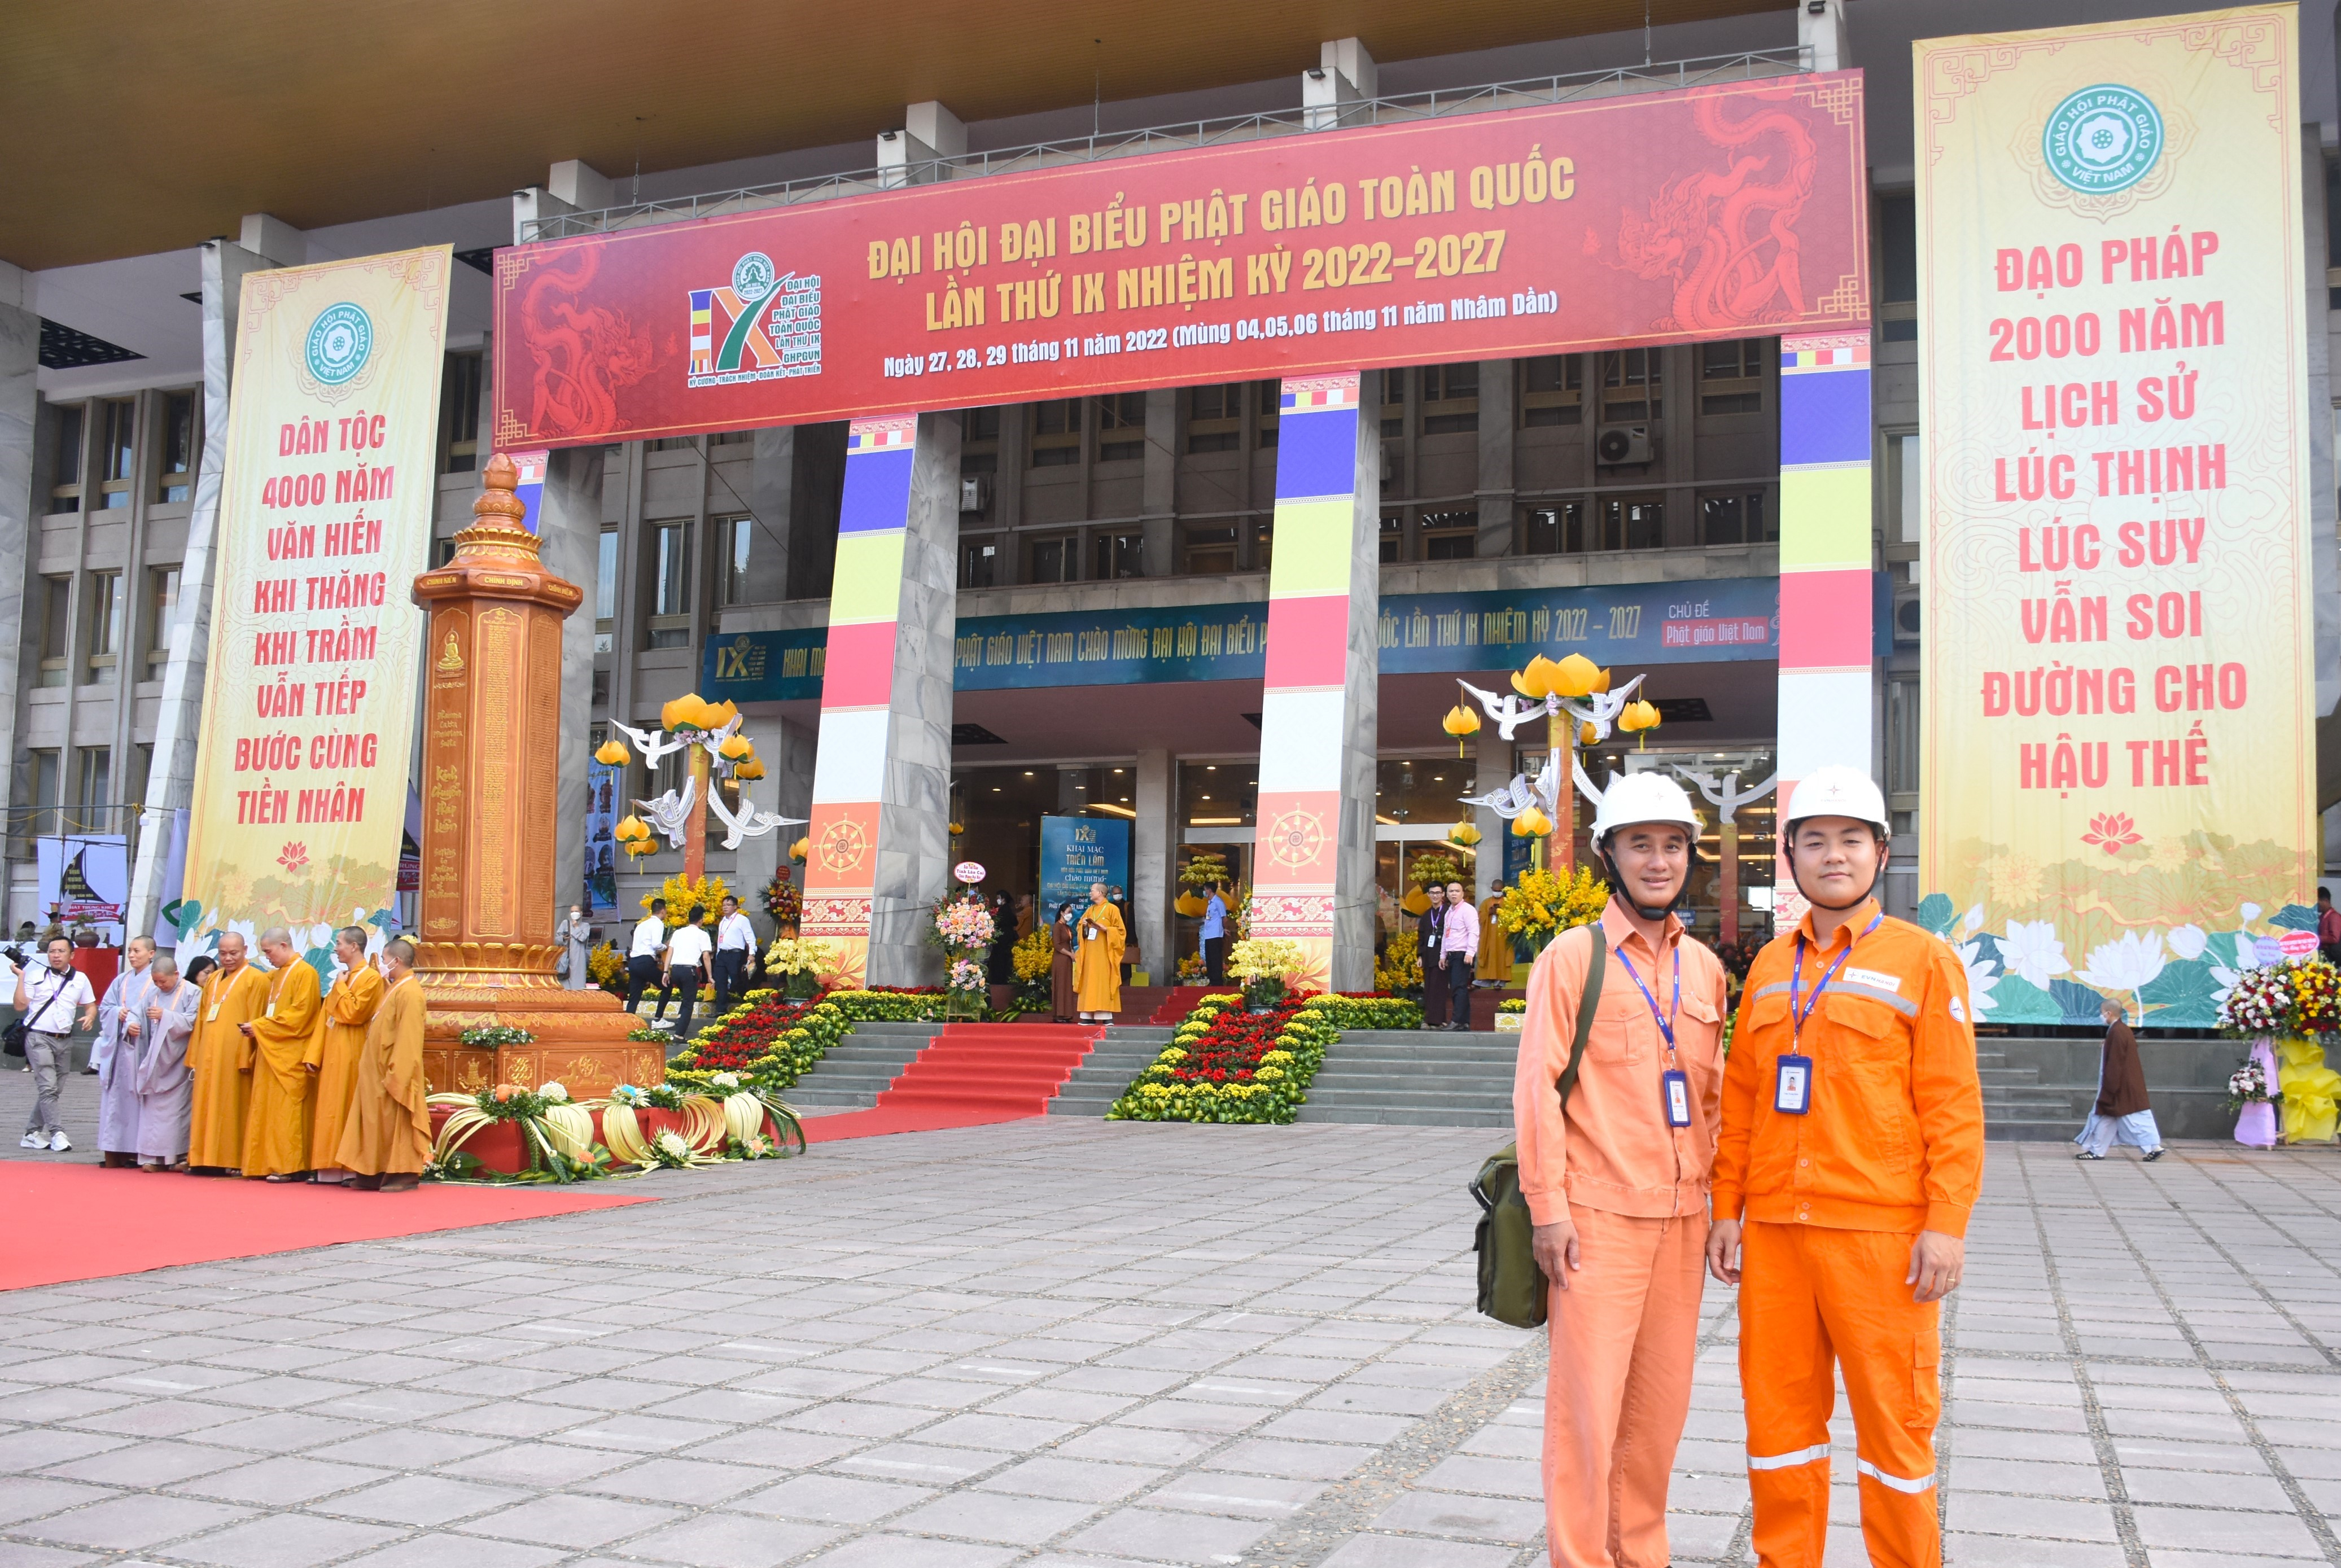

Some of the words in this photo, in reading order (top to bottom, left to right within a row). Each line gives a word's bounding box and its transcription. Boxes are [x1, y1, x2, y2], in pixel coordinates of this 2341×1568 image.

[2053, 121, 2069, 156] GIÁO
[2067, 98, 2093, 119] HỘI
[2097, 95, 2138, 113] PHẬT
[2136, 114, 2154, 149] GIÁO
[2072, 166, 2101, 185] VIỆT
[2103, 163, 2135, 183] NAM
[867, 235, 921, 284] ĐẠI
[933, 220, 987, 276] HỘI
[999, 217, 1056, 268] ĐẠI
[1069, 191, 1147, 255] BIỂU
[1160, 188, 1248, 246] PHẬT
[1260, 177, 1346, 233] GIÁO
[1359, 165, 1455, 221] TOÀN
[1469, 143, 1575, 211] QUỐC
[787, 279, 803, 291] ĐẠI
[804, 276, 820, 290] HỘI
[926, 274, 985, 332] LẦN
[996, 270, 1062, 323] THỨ
[1073, 272, 1105, 315] IX
[1117, 253, 1233, 312] NHIỆM
[1247, 244, 1291, 296] KỲ
[1302, 229, 1506, 291] 2022-2027
[1994, 242, 2083, 299] ĐẠO
[2101, 224, 2220, 285] PHÁP
[773, 307, 796, 321] PHẬT
[798, 305, 820, 317] GIÁO
[782, 295, 797, 308] ĐẠI
[799, 289, 820, 304] BIỂU
[312, 330, 322, 356] GIÁO
[321, 313, 336, 329] HỘI
[339, 311, 361, 324] PHẬT
[358, 325, 367, 351] GIÁO
[770, 321, 792, 335] TOÀN
[795, 318, 820, 332] QUỐC
[776, 335, 790, 349] LẦN
[793, 334, 808, 347] THỨ
[811, 334, 820, 345] IX
[883, 356, 924, 378] Ngày
[929, 352, 953, 373] 27,
[956, 348, 982, 370] 28,
[986, 345, 1007, 366] 29
[1012, 338, 1060, 365] tháng
[1064, 338, 1079, 358] 11
[1083, 332, 1122, 357] năm
[1126, 328, 1168, 352] 2022
[1172, 321, 1231, 348] (Mùng
[1236, 313, 1318, 341] 04,05,06
[1323, 306, 1376, 332] tháng
[1381, 305, 1398, 327] 11
[1403, 300, 1445, 326] năm
[1451, 293, 1506, 321] Nhâm
[1512, 287, 1558, 316] Dần)
[1989, 312, 2101, 362] 2000
[2119, 296, 2225, 354] NĂM
[320, 364, 336, 378] VIỆT
[336, 361, 355, 376] NAM
[698, 376, 716, 386] CƯƠNG
[719, 373, 736, 383] TRÁCH
[738, 371, 756, 382] NHIỆM
[759, 369, 774, 379] ĐOÀN
[776, 367, 786, 378] KẾT
[789, 366, 802, 375] PHÁT
[804, 362, 820, 374] TRIỂN
[784, 350, 820, 363] GHPGVN
[2021, 380, 2118, 440] LỊCH
[2136, 360, 2199, 423] SỬ
[279, 415, 330, 457] DÂN
[339, 409, 386, 457] TỘC
[262, 472, 326, 509] 4000
[335, 462, 395, 503] NĂM
[1994, 446, 2076, 502] LÚC
[2092, 443, 2226, 504] THỊNH
[268, 520, 321, 560] VĂN
[324, 507, 382, 557] HIẾN
[2019, 516, 2101, 572] LÚC
[2117, 516, 2206, 568] SUY
[255, 579, 296, 614] KHI
[484, 576, 505, 585] CHÍNH
[507, 577, 523, 586] ĐỊNH
[1405, 606, 1429, 648] LẦN
[1436, 609, 1461, 647] THỨ
[1465, 613, 1478, 646] IX
[1483, 607, 1526, 650] NHIỆM
[1532, 605, 1550, 643] KỲ
[1555, 608, 1587, 642] 2022
[1608, 606, 1642, 640] 2027
[1669, 601, 1692, 619] CHỦ
[1695, 599, 1709, 618] ĐỀ
[2021, 579, 2108, 644] VẪN
[2125, 590, 2202, 641] SOI
[255, 630, 296, 666] KHI
[307, 615, 377, 663] TRẦM
[955, 632, 983, 672] PHẬT
[986, 630, 1013, 666] GIÁO
[1016, 629, 1043, 670] VIỆT
[1046, 632, 1073, 663] NAM
[1078, 626, 1108, 662] CHÀO
[1113, 624, 1148, 661] MỪNG
[1152, 627, 1173, 664] ĐẠI
[1177, 621, 1197, 662] HỘI
[1201, 624, 1223, 661] ĐẠI
[1226, 615, 1256, 655] BIỂU
[1666, 624, 1691, 647] Phật
[1718, 621, 1739, 645] Việt
[1743, 621, 1765, 641] Nam
[782, 648, 808, 677] KHAI
[809, 646, 827, 681] MẠ
[257, 671, 305, 719] VẪN
[314, 668, 366, 716] TIẾP
[1980, 659, 2136, 717] ĐƯỜNG
[2154, 662, 2247, 713] CHO
[234, 730, 301, 772] BƯỚC
[311, 728, 378, 770] CÙNG
[2020, 732, 2108, 799] HẬU
[2125, 719, 2209, 787] THẾ
[237, 777, 289, 825] TIỀN
[296, 781, 365, 824] NHÂN
[1066, 852, 1086, 865] TRIỂN
